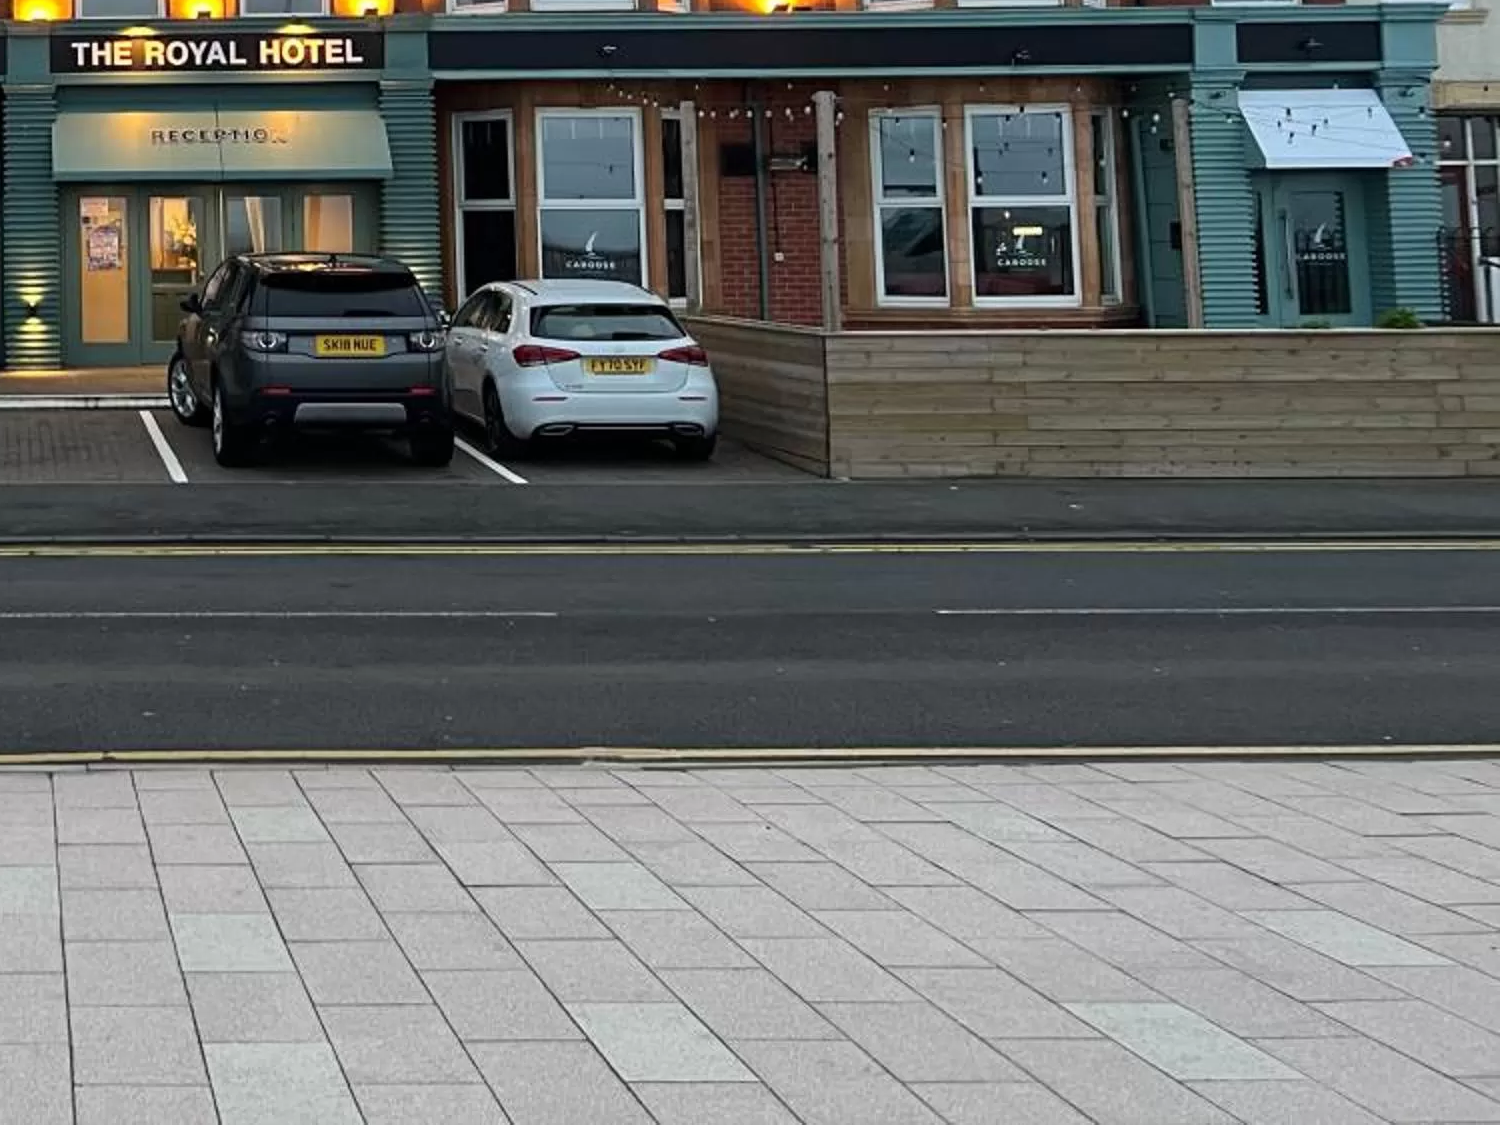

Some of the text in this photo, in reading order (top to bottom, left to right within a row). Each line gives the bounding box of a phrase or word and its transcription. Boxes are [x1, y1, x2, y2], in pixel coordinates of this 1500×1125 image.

[71, 39, 364, 66] THE ROYAL HOTEL
